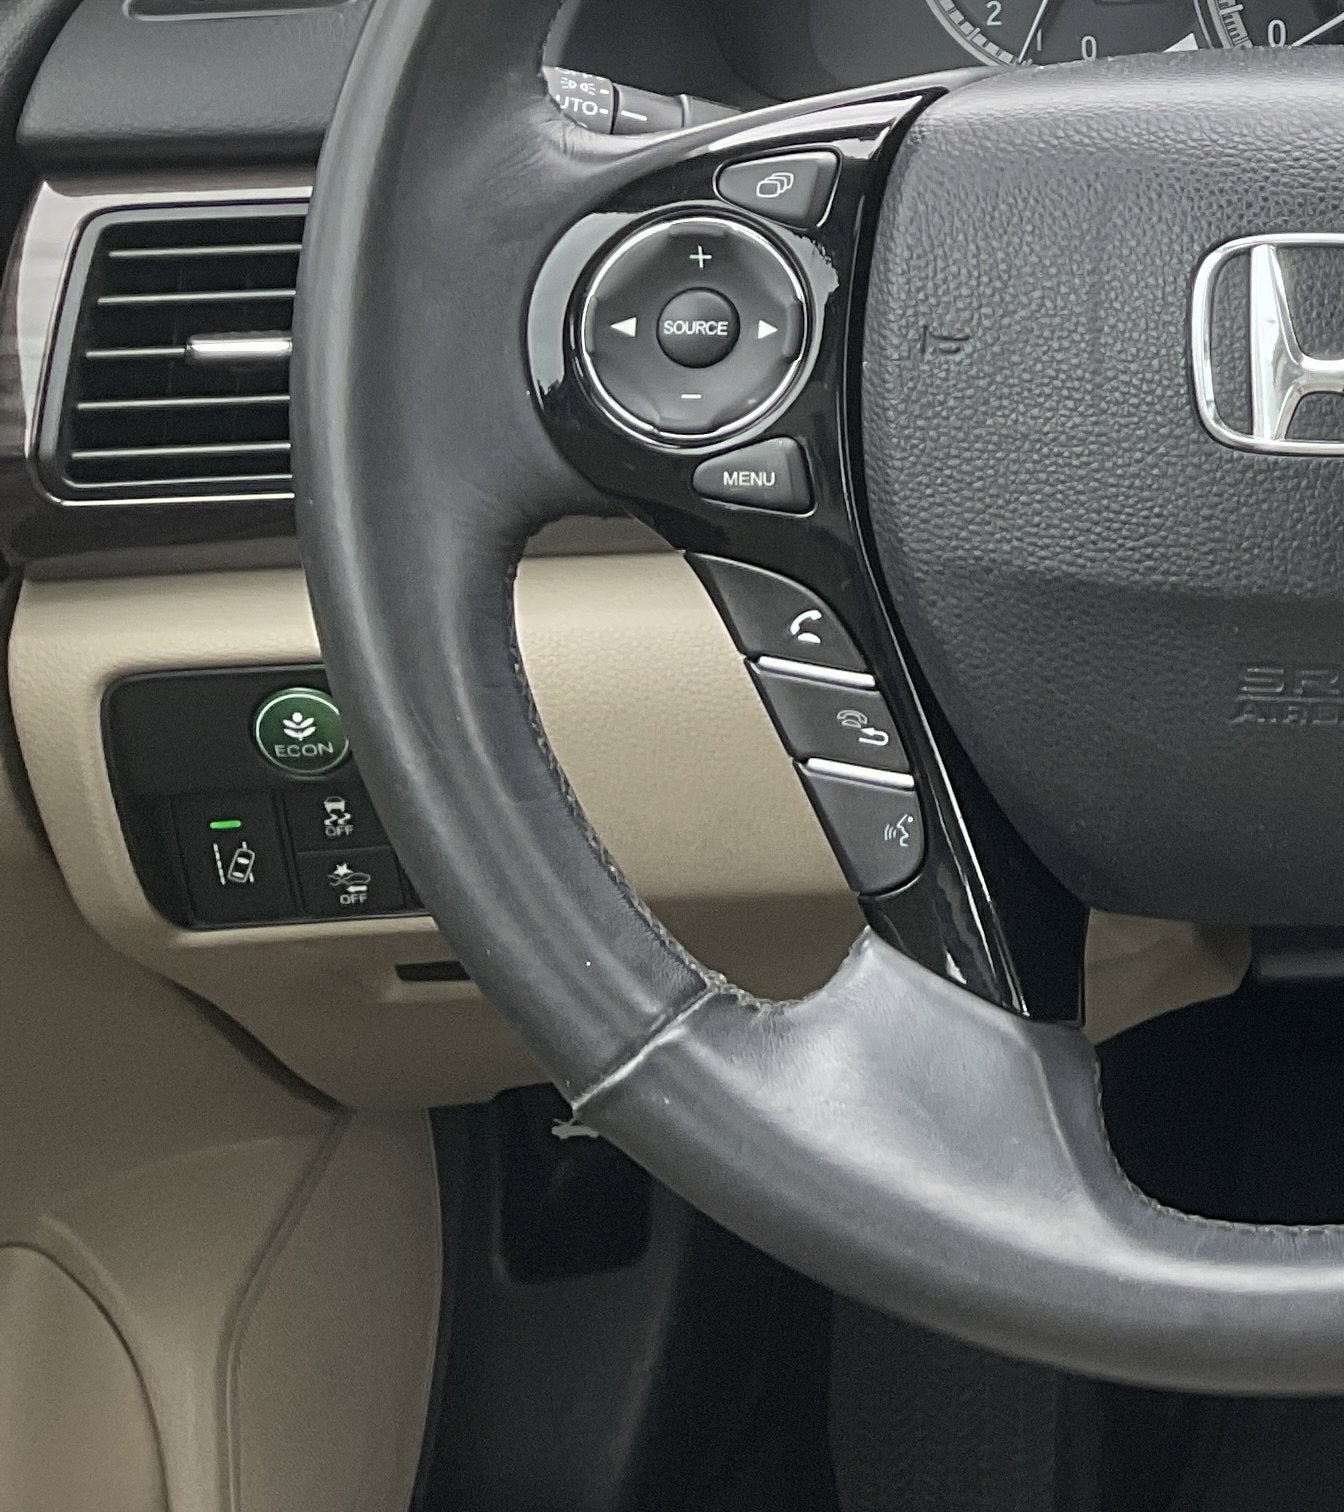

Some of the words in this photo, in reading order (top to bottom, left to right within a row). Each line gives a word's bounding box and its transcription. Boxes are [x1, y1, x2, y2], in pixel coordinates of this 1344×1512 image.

[985, 0, 1003, 26] 2
[1267, 18, 1287, 47] 0
[1080, 35, 1098, 61] 0
[555, 94, 599, 116] UTO
[662, 319, 729, 336] SOURCE
[722, 470, 777, 487] MENU
[273, 741, 334, 759] ECON
[325, 825, 354, 838] OFF
[340, 892, 368, 906] OFF
